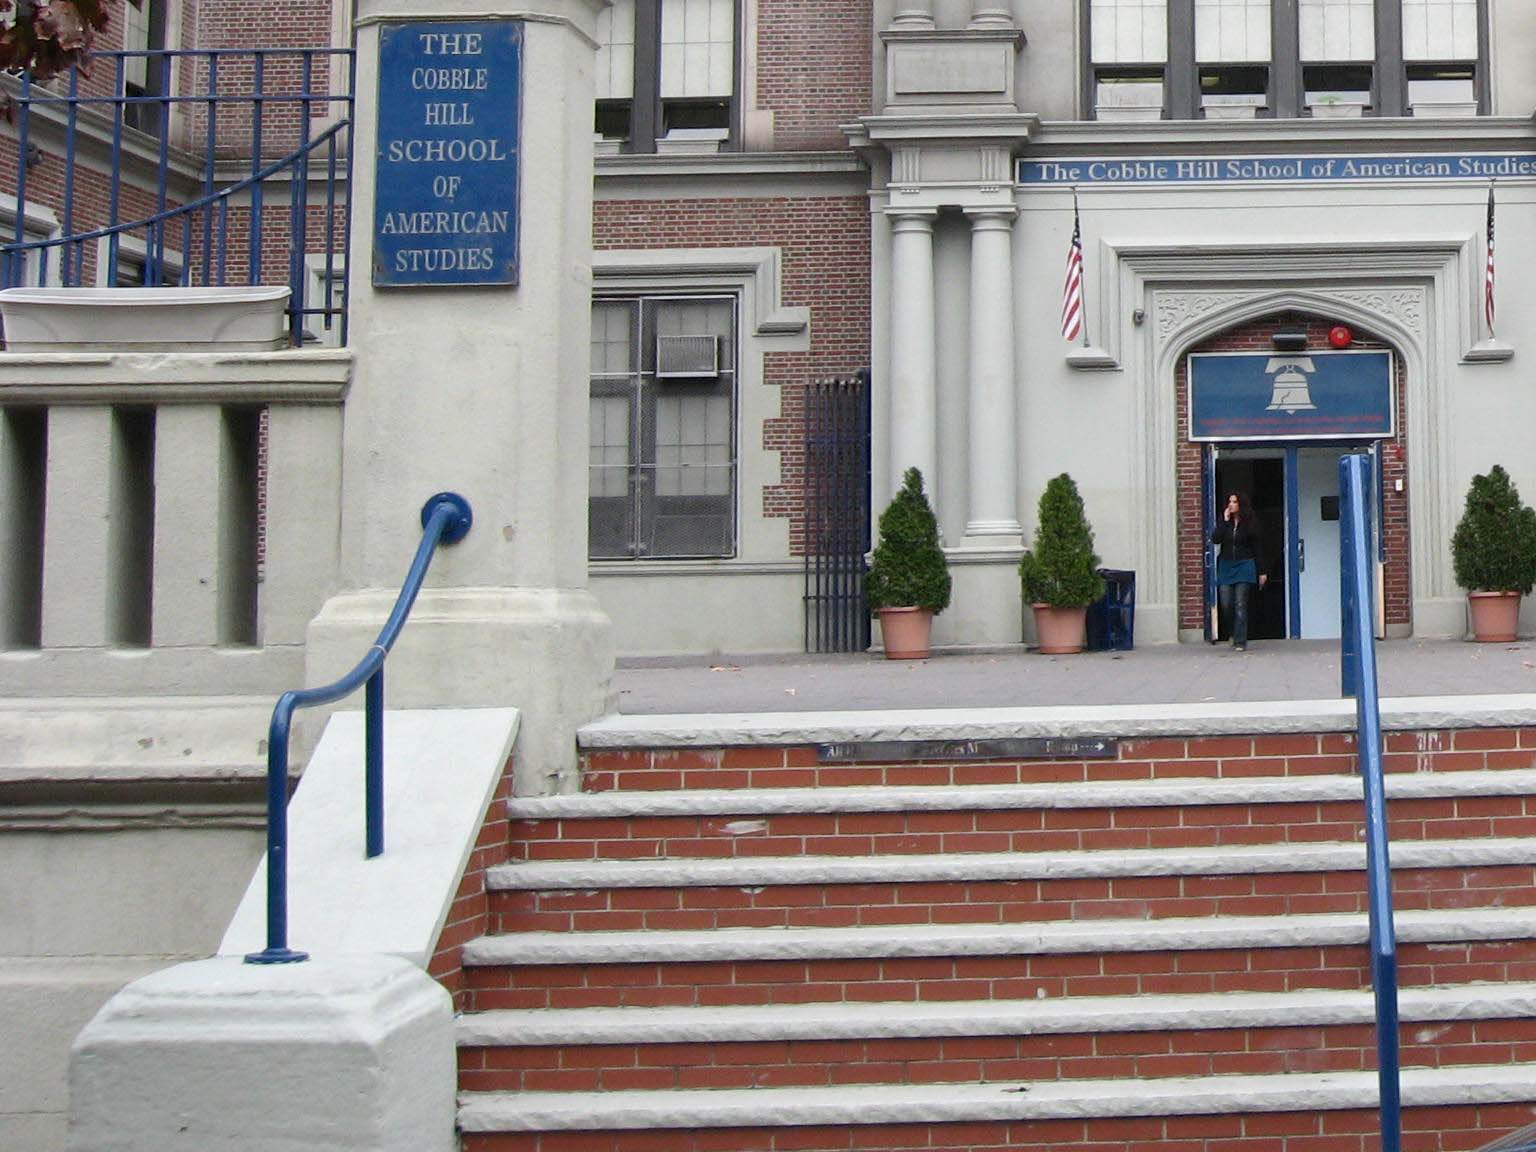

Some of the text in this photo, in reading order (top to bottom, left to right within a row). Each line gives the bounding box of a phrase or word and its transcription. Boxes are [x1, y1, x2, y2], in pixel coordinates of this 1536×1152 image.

[419, 33, 482, 55] THE
[412, 68, 488, 90] COBBLE
[425, 102, 474, 126] HILL
[388, 139, 506, 163] SCHOOL
[1036, 162, 1080, 181] The
[1088, 162, 1168, 181] Cobble
[1176, 161, 1218, 179] Hill
[1226, 159, 1302, 179] School
[1312, 160, 1336, 177] of
[1341, 159, 1450, 178] American
[433, 176, 461, 198] OF
[382, 211, 507, 234] AMERICAN
[396, 248, 493, 272] STUDIES
